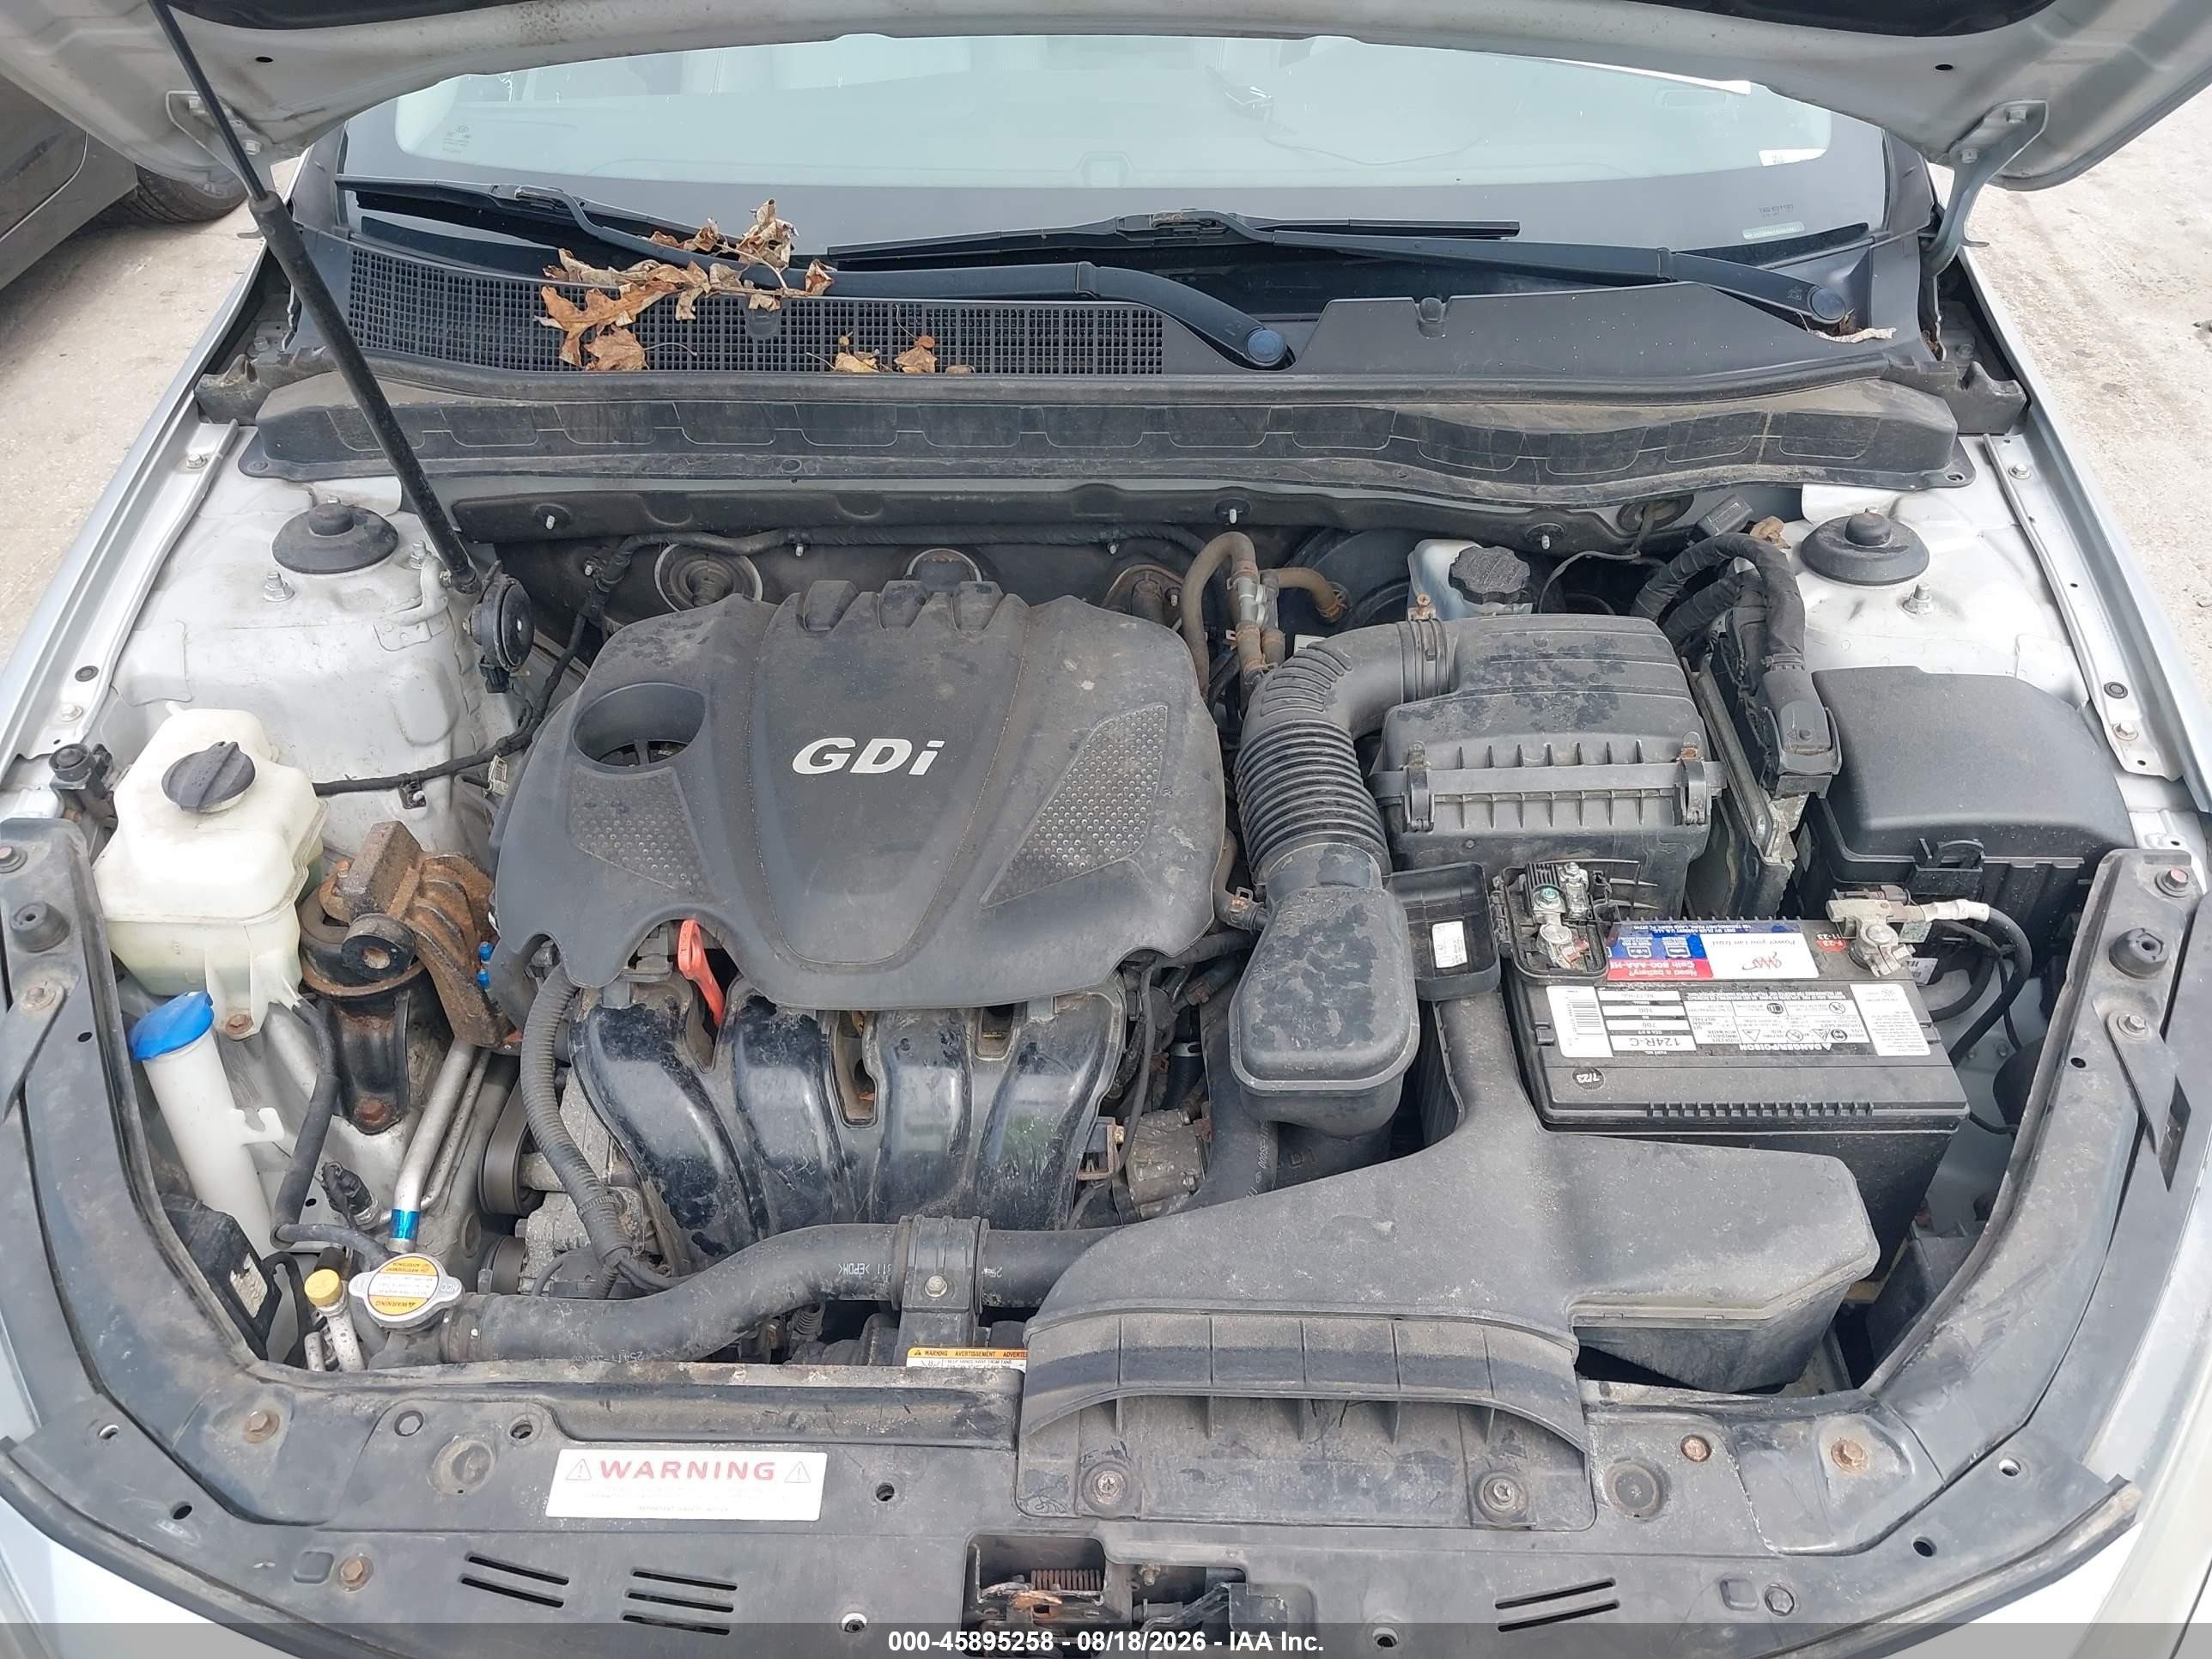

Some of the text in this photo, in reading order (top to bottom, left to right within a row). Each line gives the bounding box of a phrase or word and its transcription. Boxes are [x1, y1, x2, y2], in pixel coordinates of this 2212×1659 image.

[792, 737, 945, 775] GDi
[1577, 1073, 1600, 1083] 7/23
[441, 1283, 458, 1291] HCC
[599, 1460, 776, 1480] WARNING
